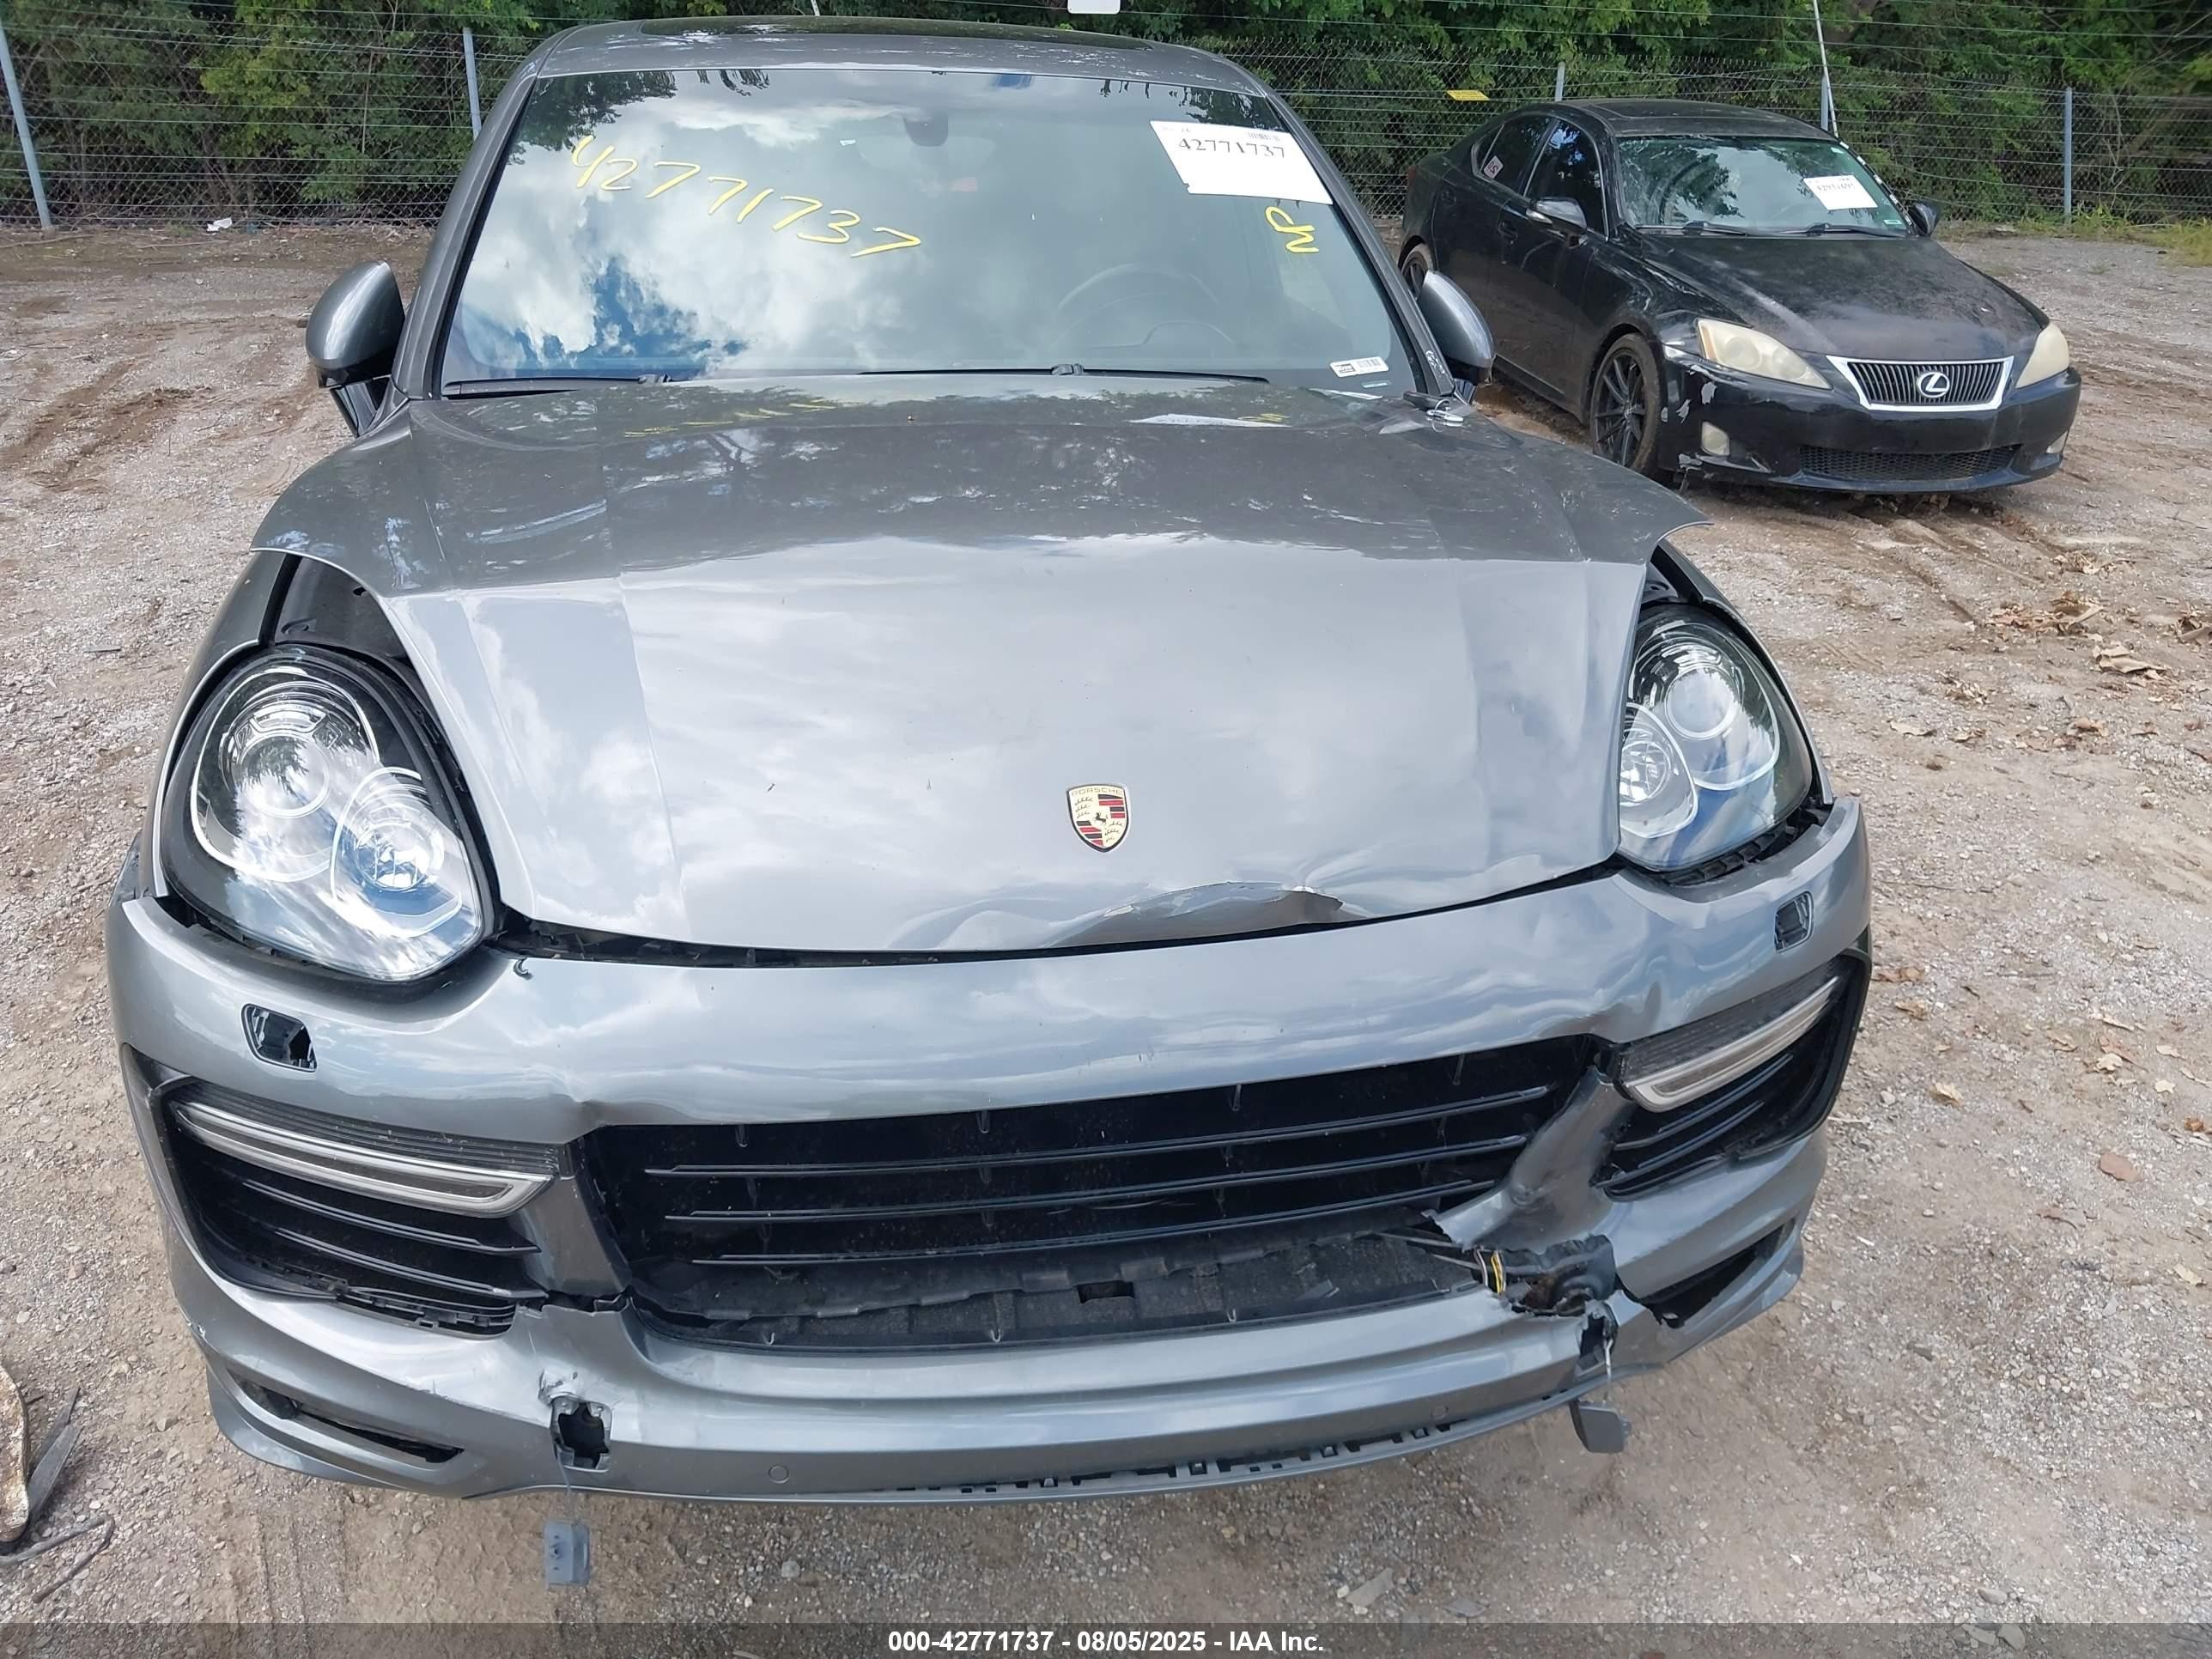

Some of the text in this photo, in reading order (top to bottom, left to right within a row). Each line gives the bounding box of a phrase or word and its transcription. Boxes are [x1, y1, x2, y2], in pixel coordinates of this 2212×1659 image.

[1178, 137, 1285, 159] 42771737
[571, 135, 921, 258] 42771737
[1071, 787, 1124, 796] PORSCHE
